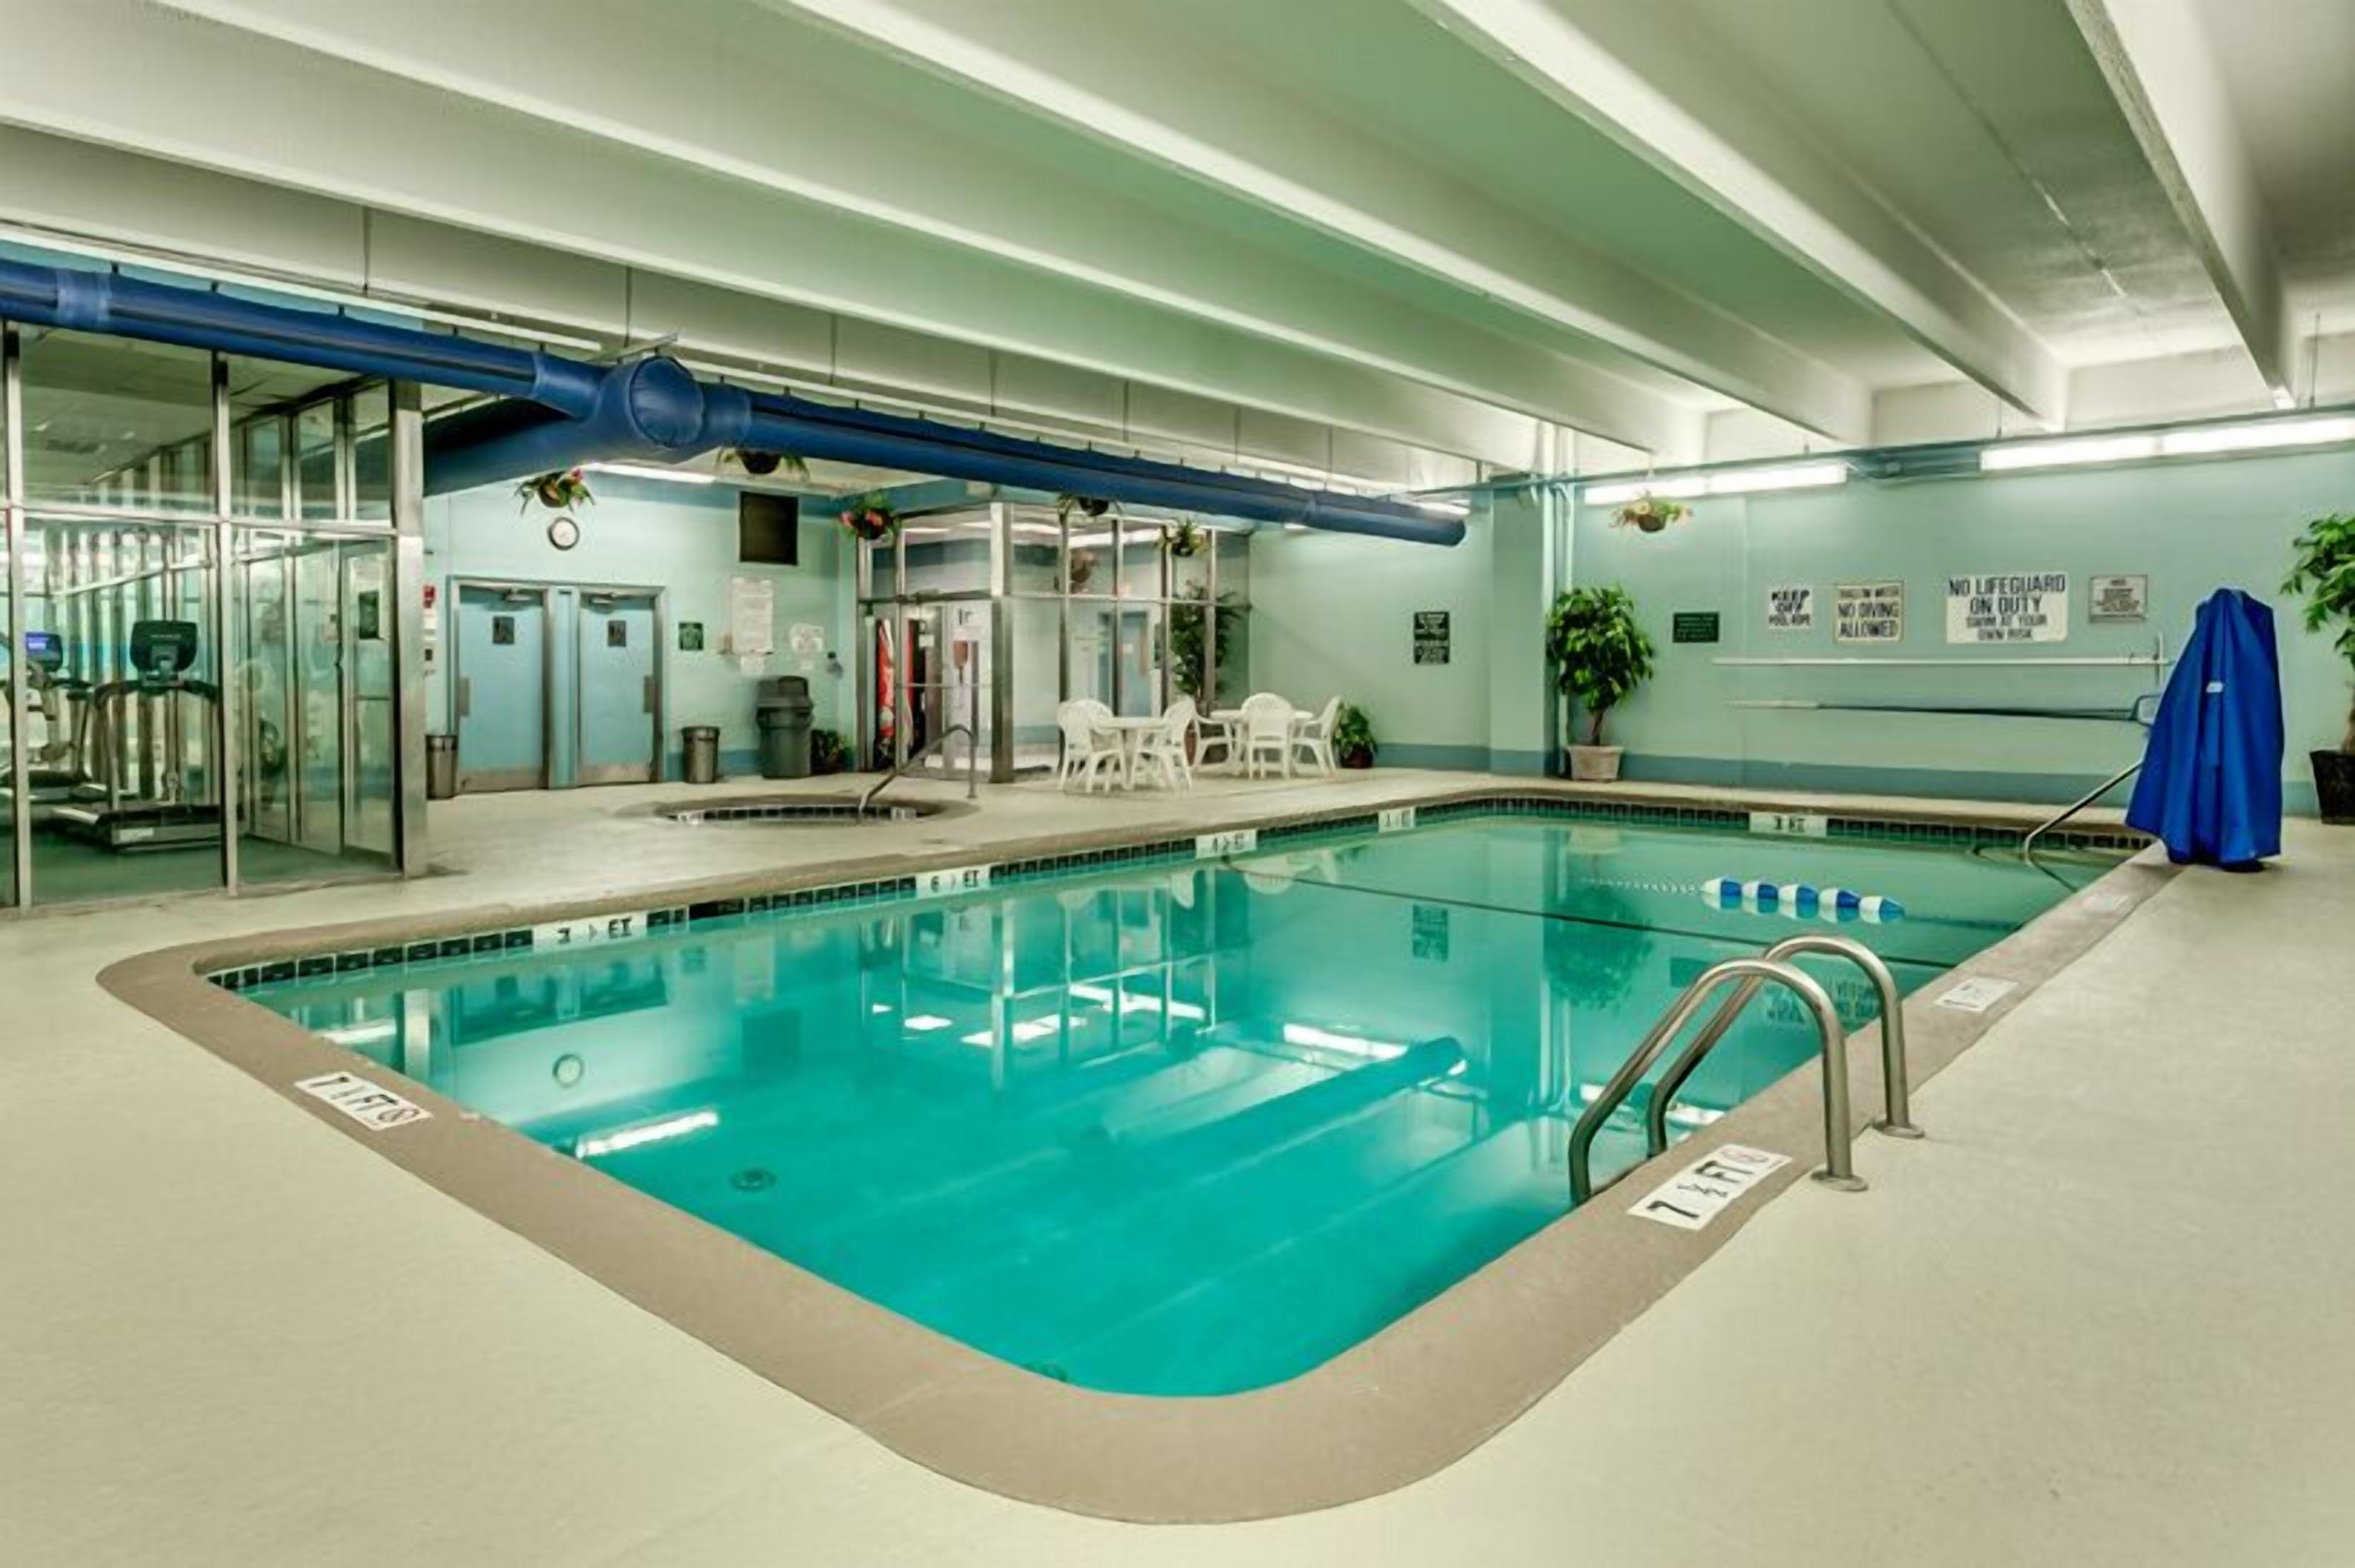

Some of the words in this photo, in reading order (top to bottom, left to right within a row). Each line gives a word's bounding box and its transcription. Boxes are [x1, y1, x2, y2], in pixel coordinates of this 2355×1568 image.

[1948, 577, 1970, 597] NO
[1975, 574, 2066, 595] LIFEGUARD
[1970, 596, 1992, 615] ON
[1998, 594, 2042, 615] DUTY
[1839, 620, 1900, 638] ALLOWED
[1646, 1200, 1699, 1219] 7
[1694, 1159, 1755, 1184] FT
